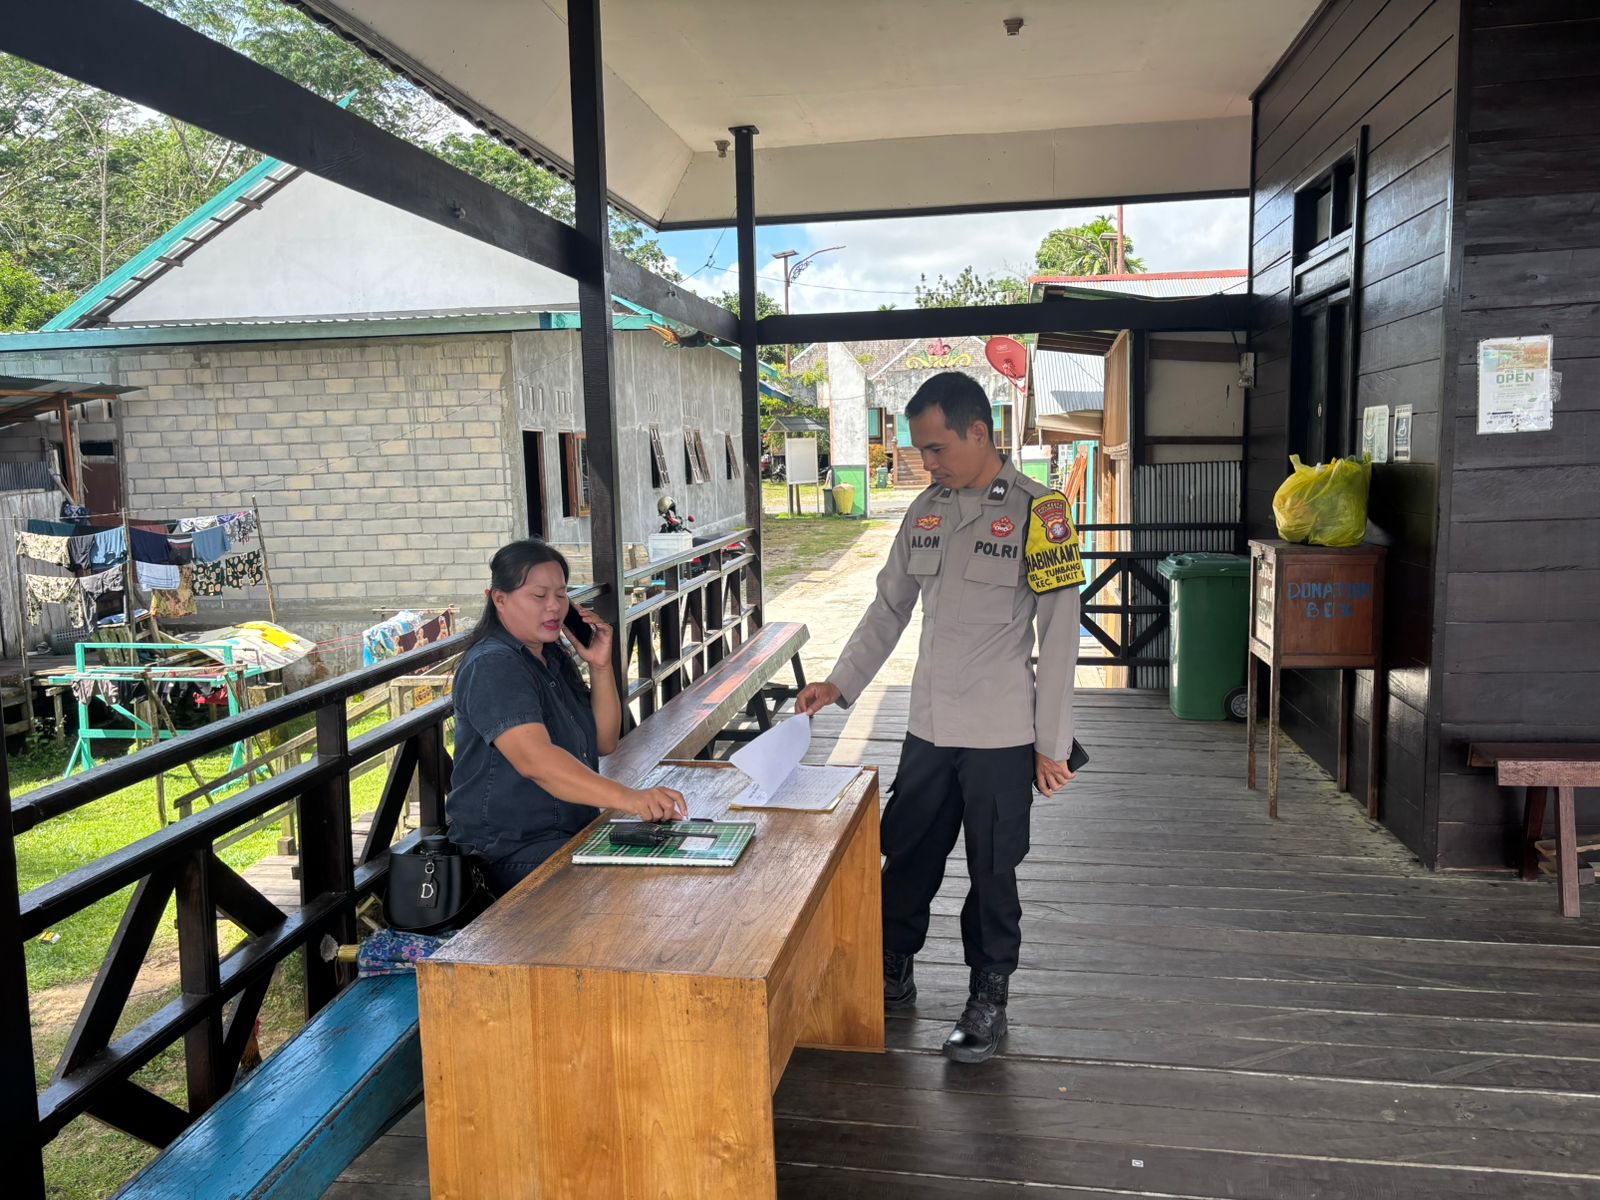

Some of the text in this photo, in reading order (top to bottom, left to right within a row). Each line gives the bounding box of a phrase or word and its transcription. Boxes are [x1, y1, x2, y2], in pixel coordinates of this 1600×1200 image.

[1496, 372, 1535, 384] OPEN
[912, 535, 940, 549] ALON
[974, 540, 1018, 559] POLRI
[1044, 563, 1081, 577] TUMBANG
[1035, 578, 1053, 589] KEC.
[1056, 571, 1078, 583] BUKIT
